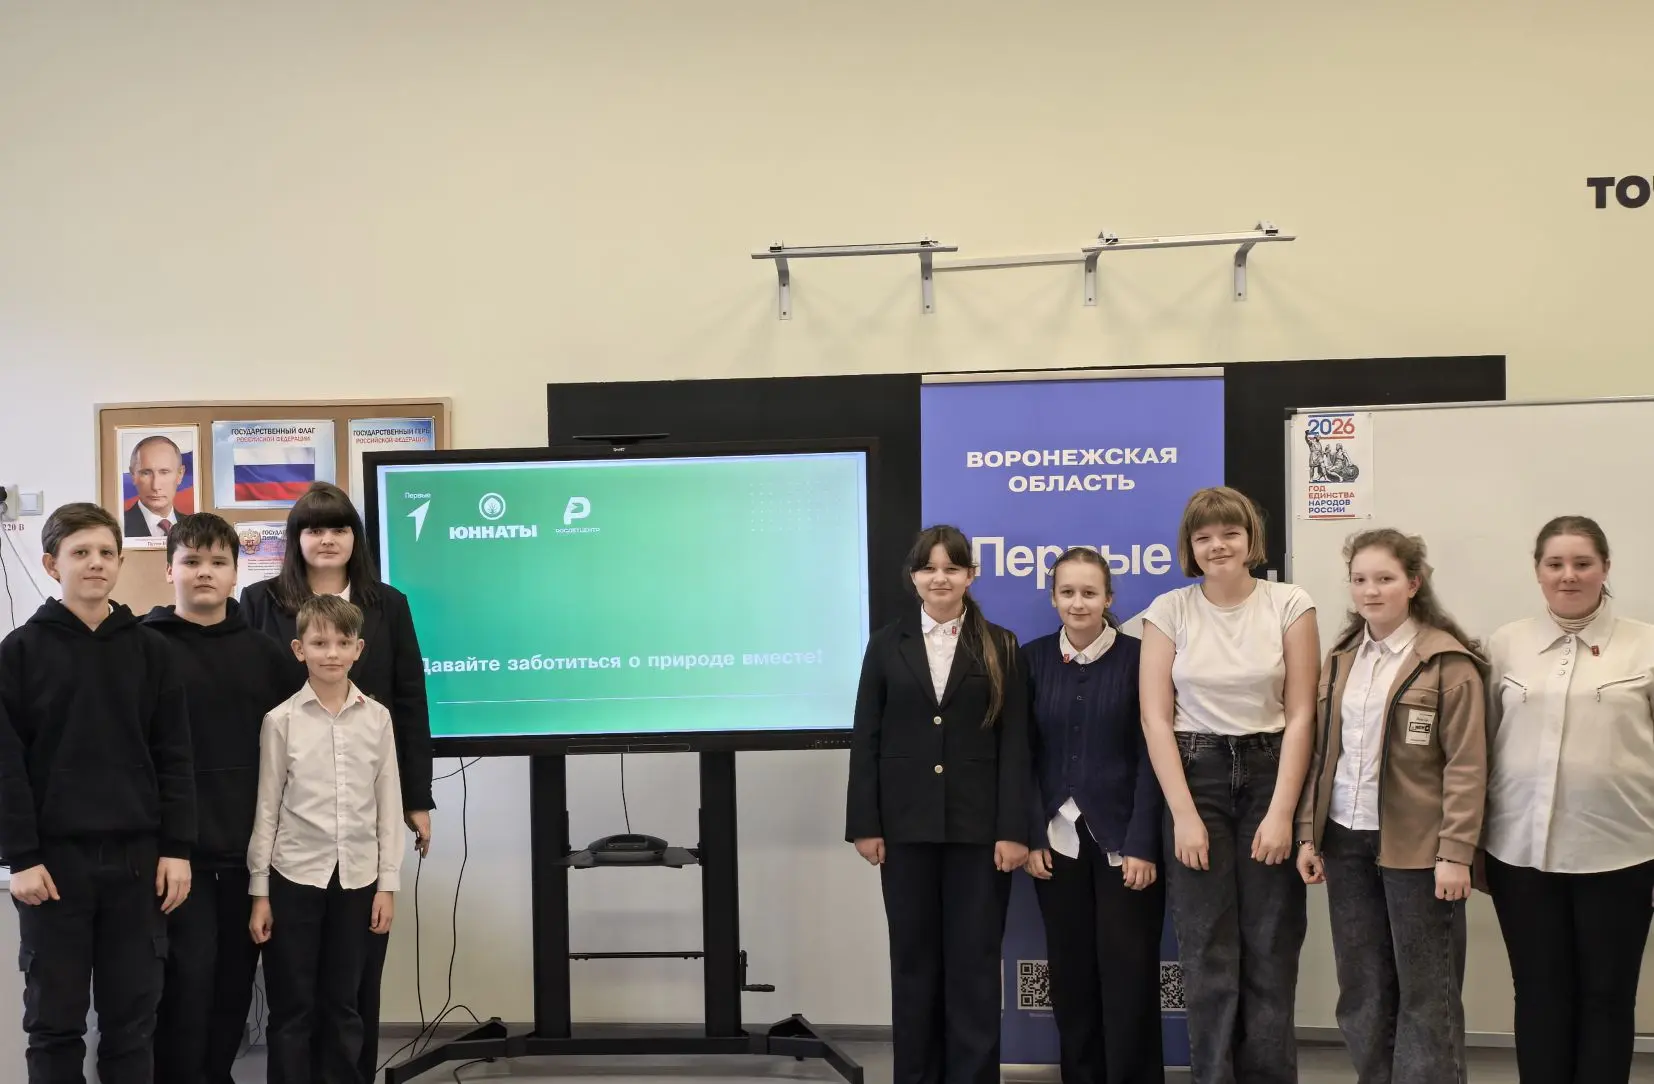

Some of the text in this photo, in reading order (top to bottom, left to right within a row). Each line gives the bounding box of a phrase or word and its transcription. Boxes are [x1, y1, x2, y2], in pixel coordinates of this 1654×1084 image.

[1587, 175, 1654, 209] ТО
[231, 427, 297, 436] ГОСУДАРСТВЕННЫЙ
[353, 428, 414, 436] ГОСУДАРСТВЕННЫЙ
[1308, 418, 1355, 435] 2026
[236, 435, 275, 443] РОССИЙСКОЙ
[966, 447, 1178, 468] ВОРОНЕЖСКАЯ
[1008, 474, 1136, 493] ОБЛАСТЬ
[404, 491, 431, 500] Первые
[1308, 492, 1355, 500] ЕДИНСТВА
[1308, 499, 1351, 507] НАРОДОВ
[1308, 506, 1346, 514] РОССИИ
[449, 524, 538, 540] ЮННАТЫ
[971, 536, 1172, 590] Перые
[507, 653, 621, 672] заботиться
[628, 658, 641, 669] о
[647, 653, 736, 670] природе
[741, 649, 823, 666] вместе!
